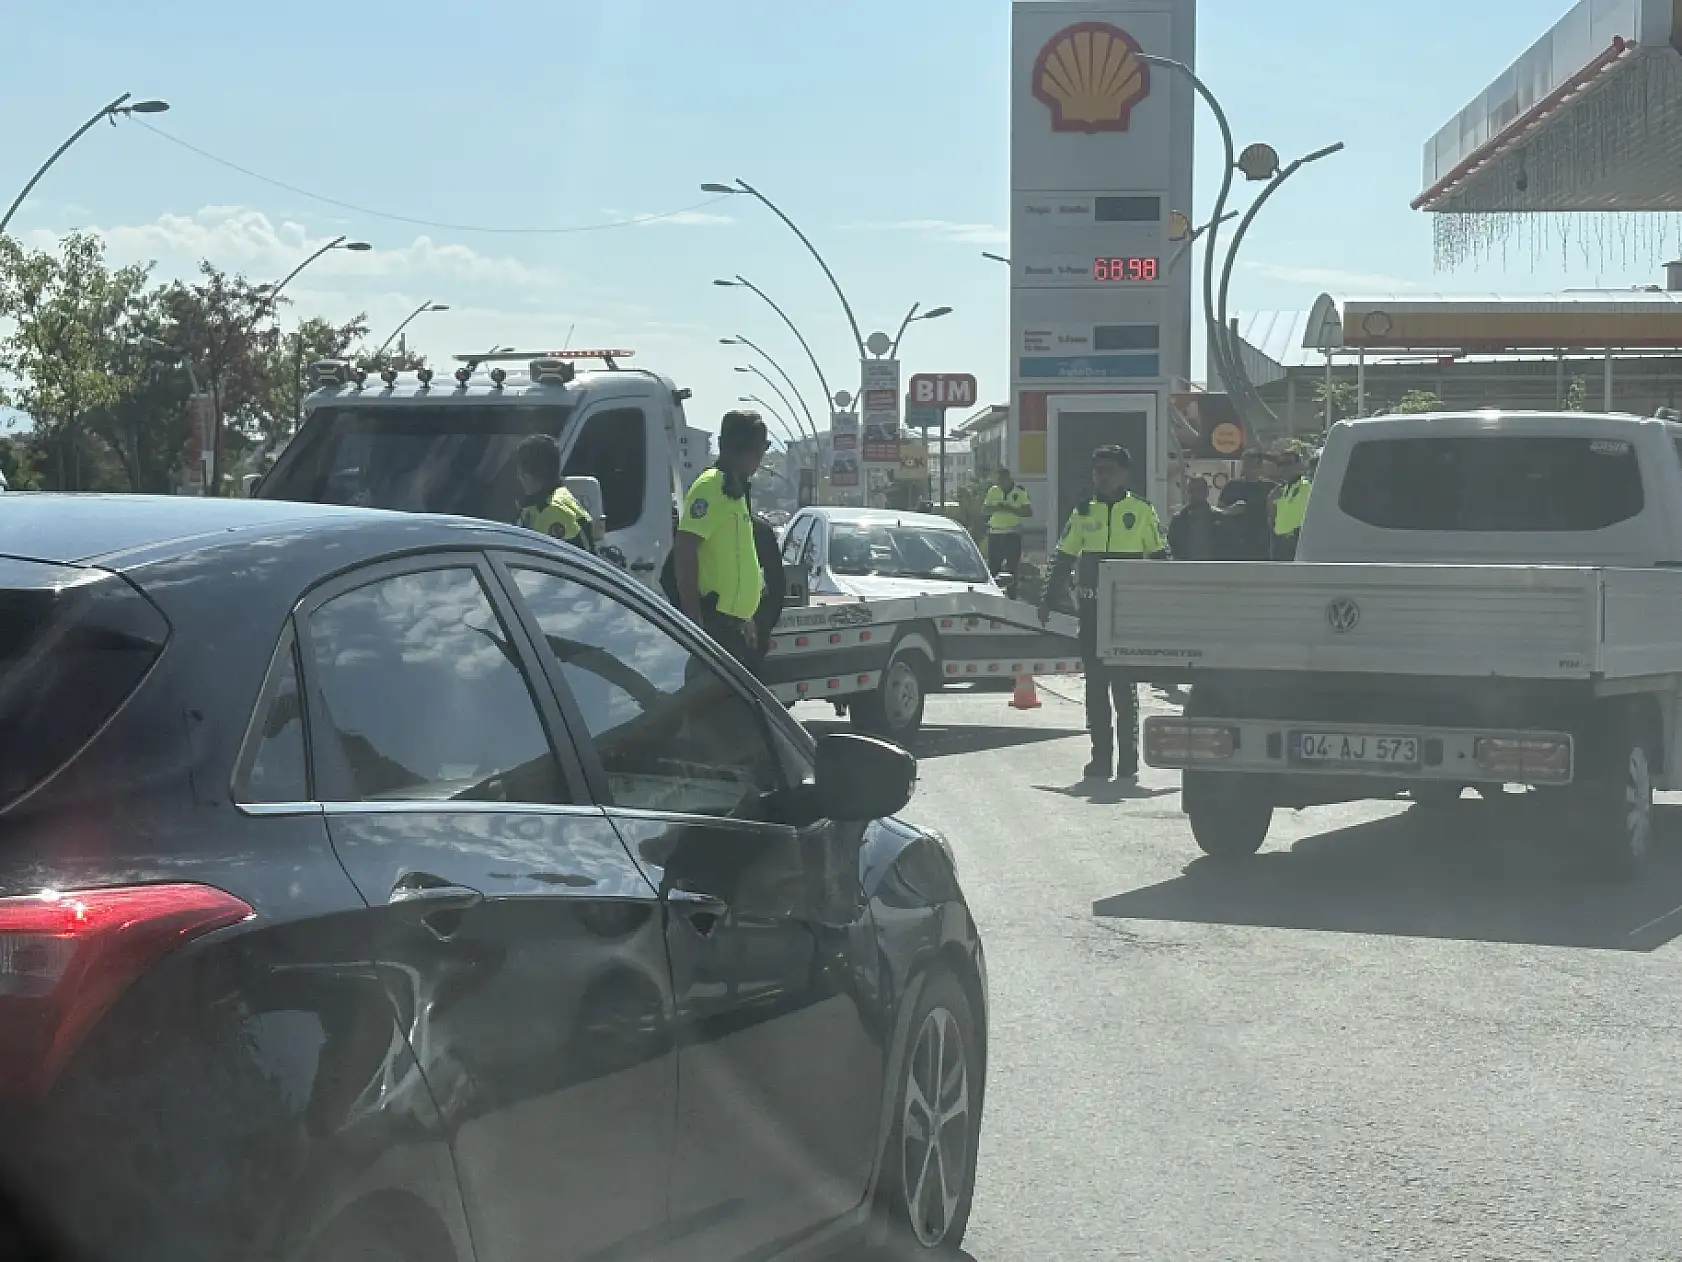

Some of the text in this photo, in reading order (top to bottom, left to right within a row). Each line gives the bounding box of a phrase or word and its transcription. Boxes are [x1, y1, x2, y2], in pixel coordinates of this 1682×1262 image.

[1095, 258, 1157, 281] 68.98
[1304, 735, 1416, 761] 04 AJ 573
